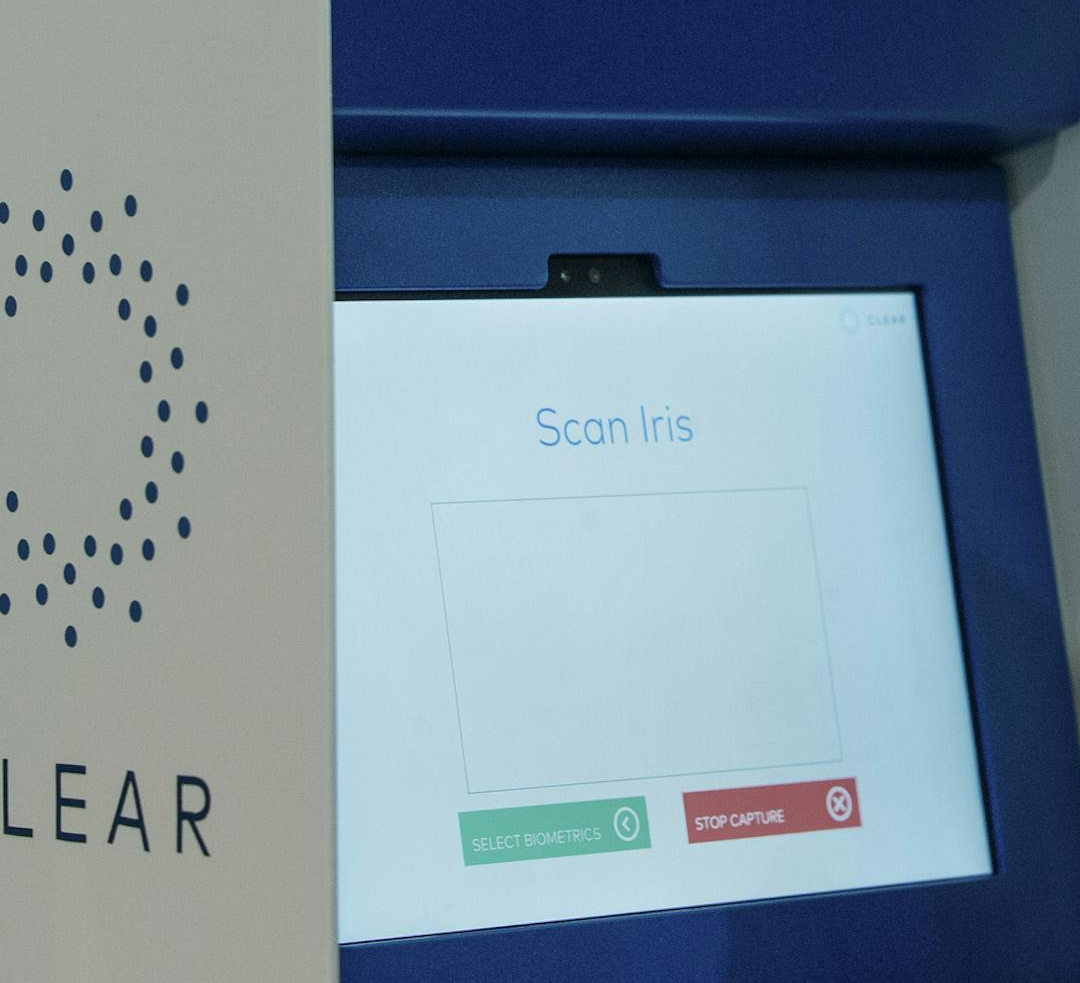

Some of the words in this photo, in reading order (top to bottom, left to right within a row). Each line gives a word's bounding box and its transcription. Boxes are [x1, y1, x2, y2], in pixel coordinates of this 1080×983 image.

[536, 407, 630, 447] Scan
[640, 404, 694, 443] Iris
[2, 758, 212, 857] LEAR
[694, 814, 727, 831] STOP
[729, 808, 785, 827] CAPTURE
[471, 833, 521, 852] SELECT
[524, 827, 602, 847] BIOMETRICS
